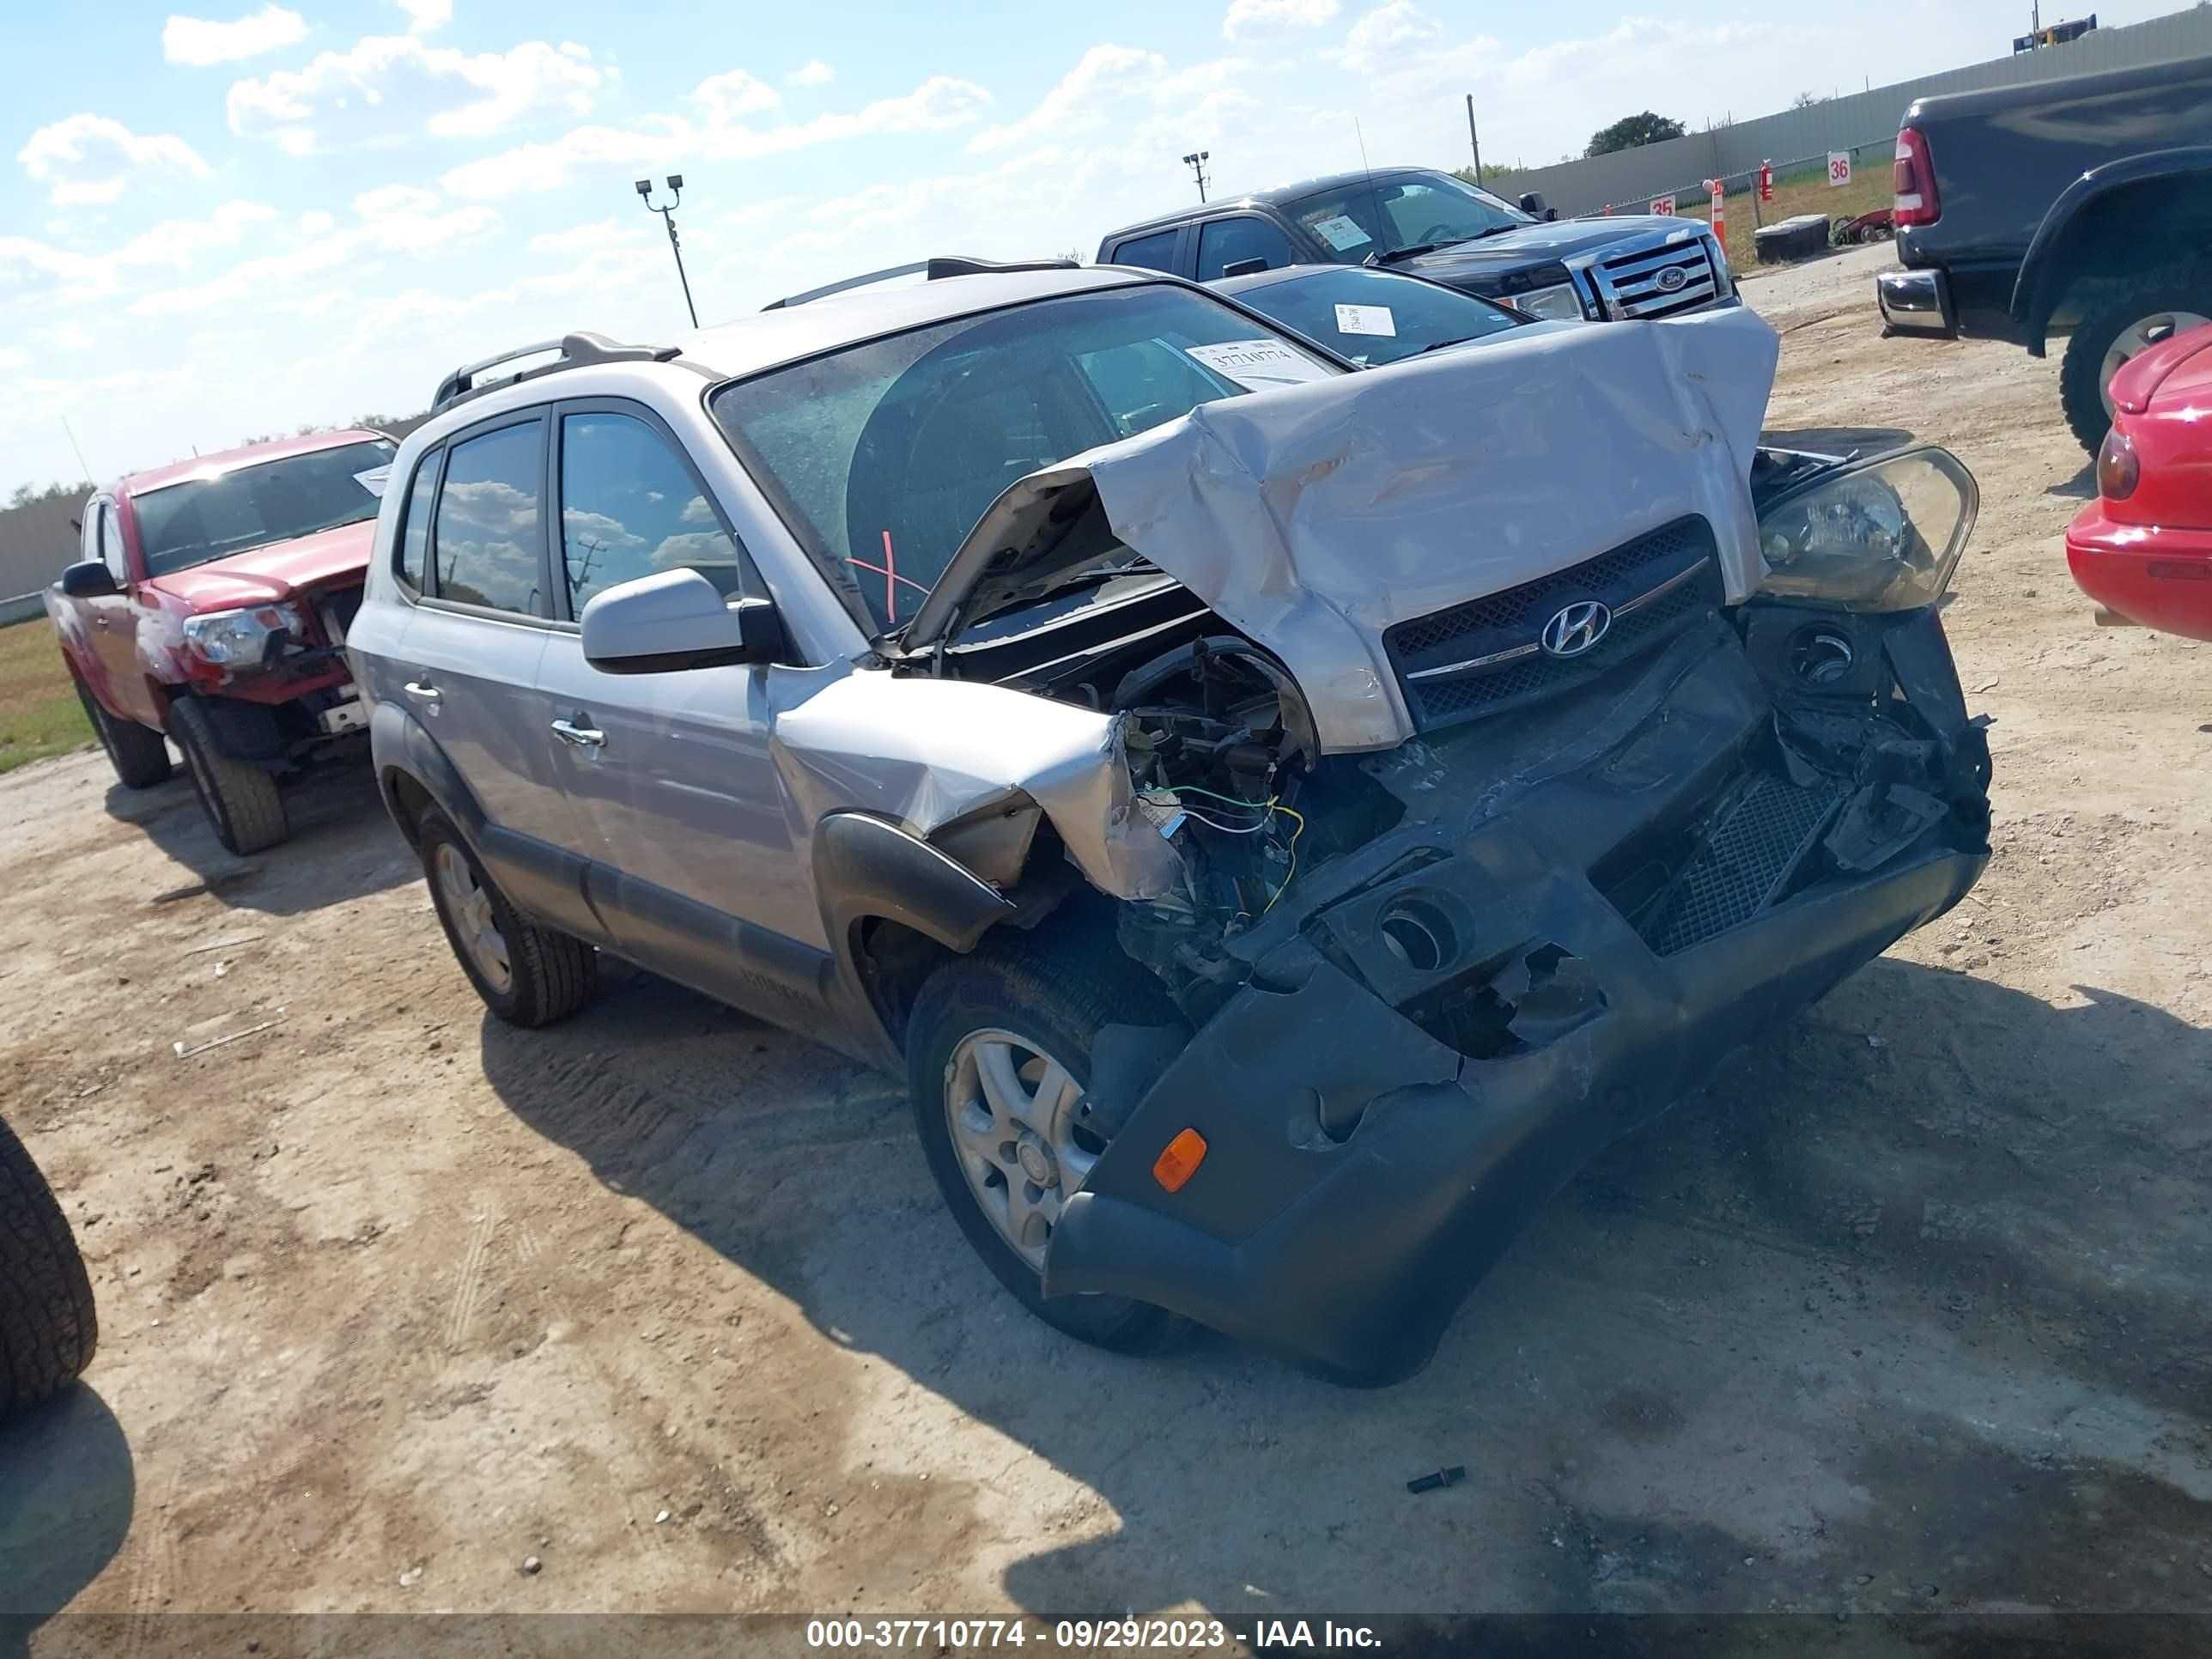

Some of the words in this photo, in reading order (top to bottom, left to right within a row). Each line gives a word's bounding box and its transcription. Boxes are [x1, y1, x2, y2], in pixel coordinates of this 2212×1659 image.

[1830, 159, 1849, 179] 36
[1652, 198, 1673, 216] 35
[1212, 349, 1292, 368] 37710774
